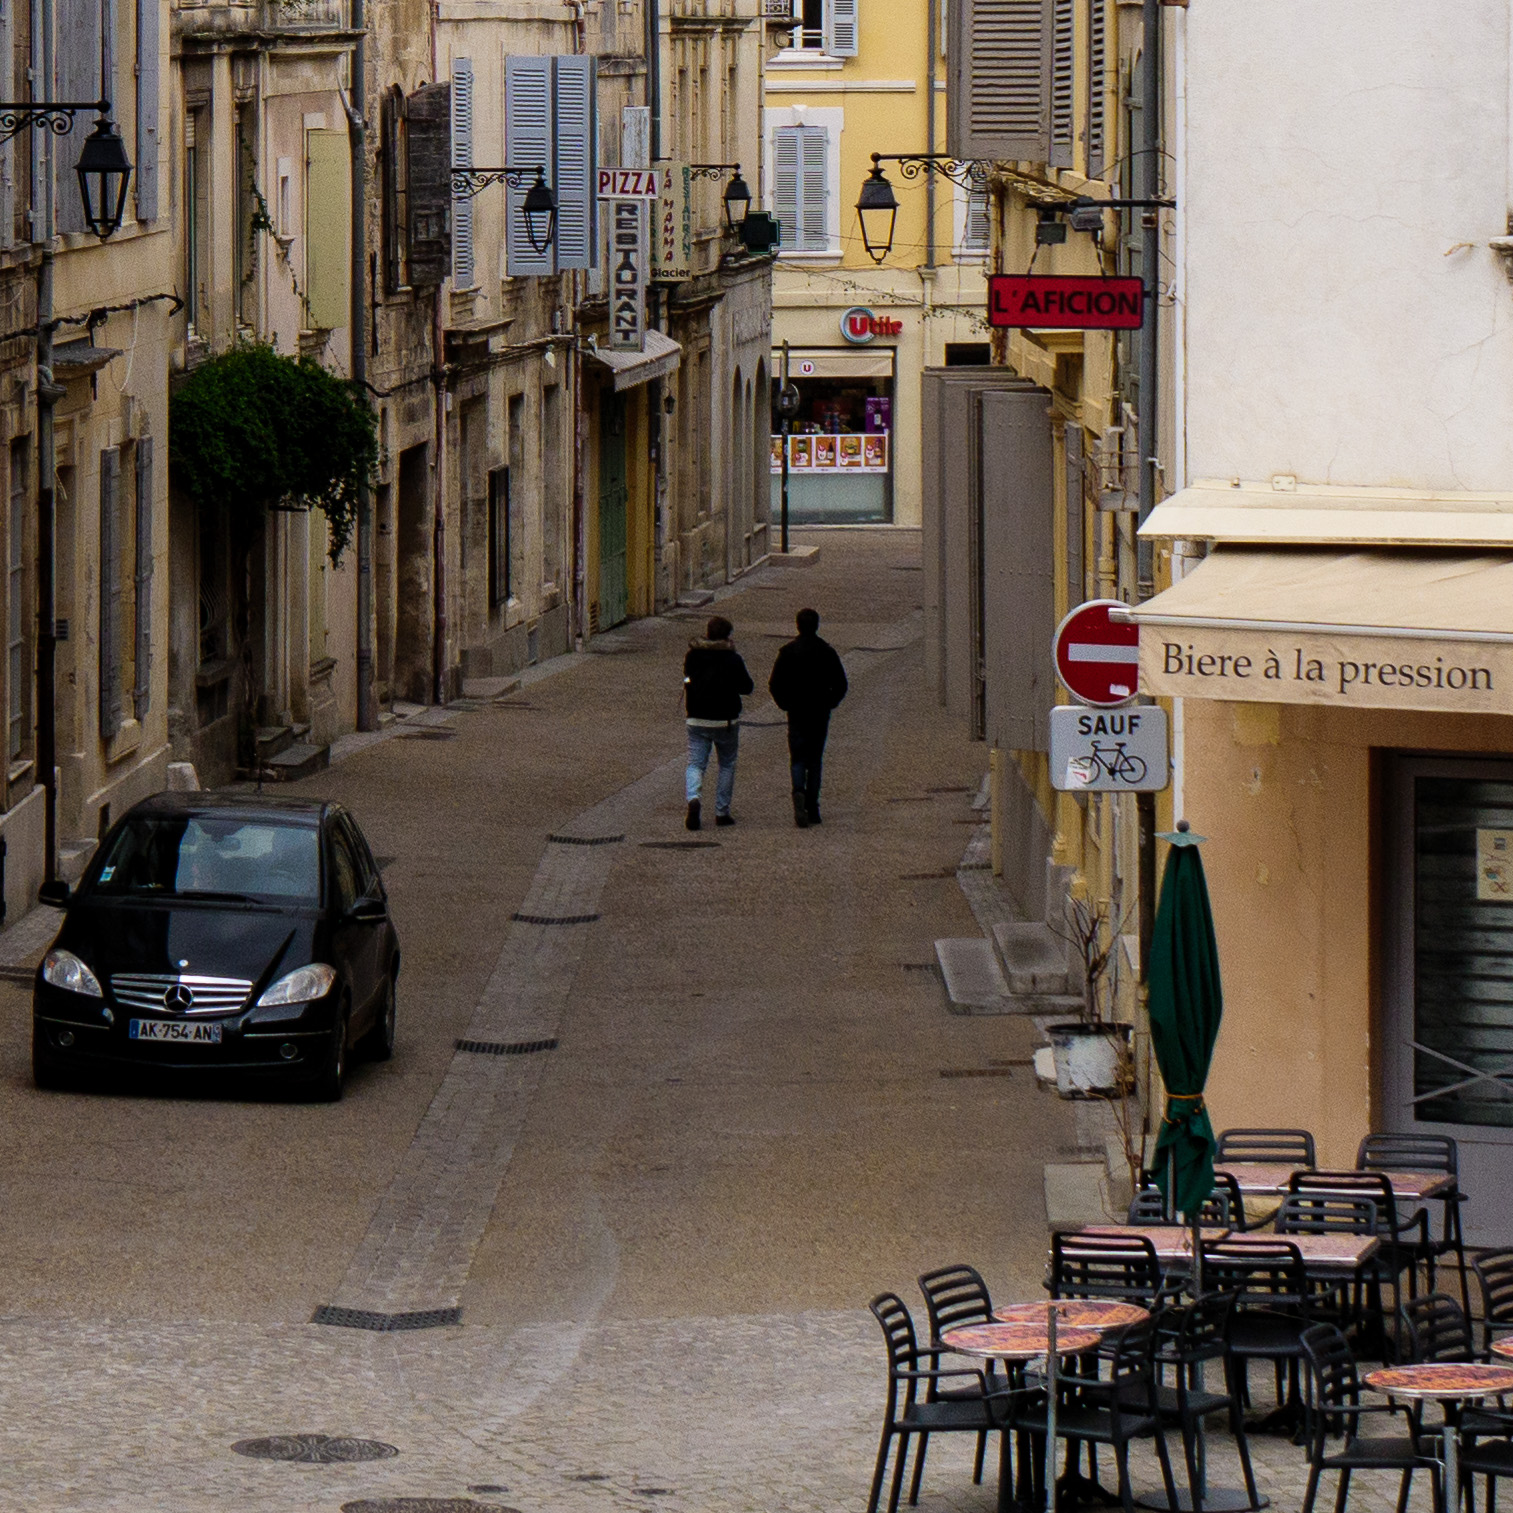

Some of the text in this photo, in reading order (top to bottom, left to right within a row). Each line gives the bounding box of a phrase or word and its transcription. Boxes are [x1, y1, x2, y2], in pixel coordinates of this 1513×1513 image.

[598, 171, 656, 195] PIZZA
[663, 168, 672, 189] LA
[663, 198, 674, 263] MAMMA
[615, 202, 638, 341] RESTAURANT
[651, 267, 691, 278] Glacier
[993, 289, 1138, 315] L'AFICION
[849, 315, 903, 336] Utile
[1161, 642, 1252, 678] Biere
[1263, 648, 1282, 680] à
[1293, 647, 1324, 682] la
[1337, 656, 1495, 693] pression
[1077, 714, 1141, 736] SAUF
[139, 1021, 212, 1040] AK-754-AN
